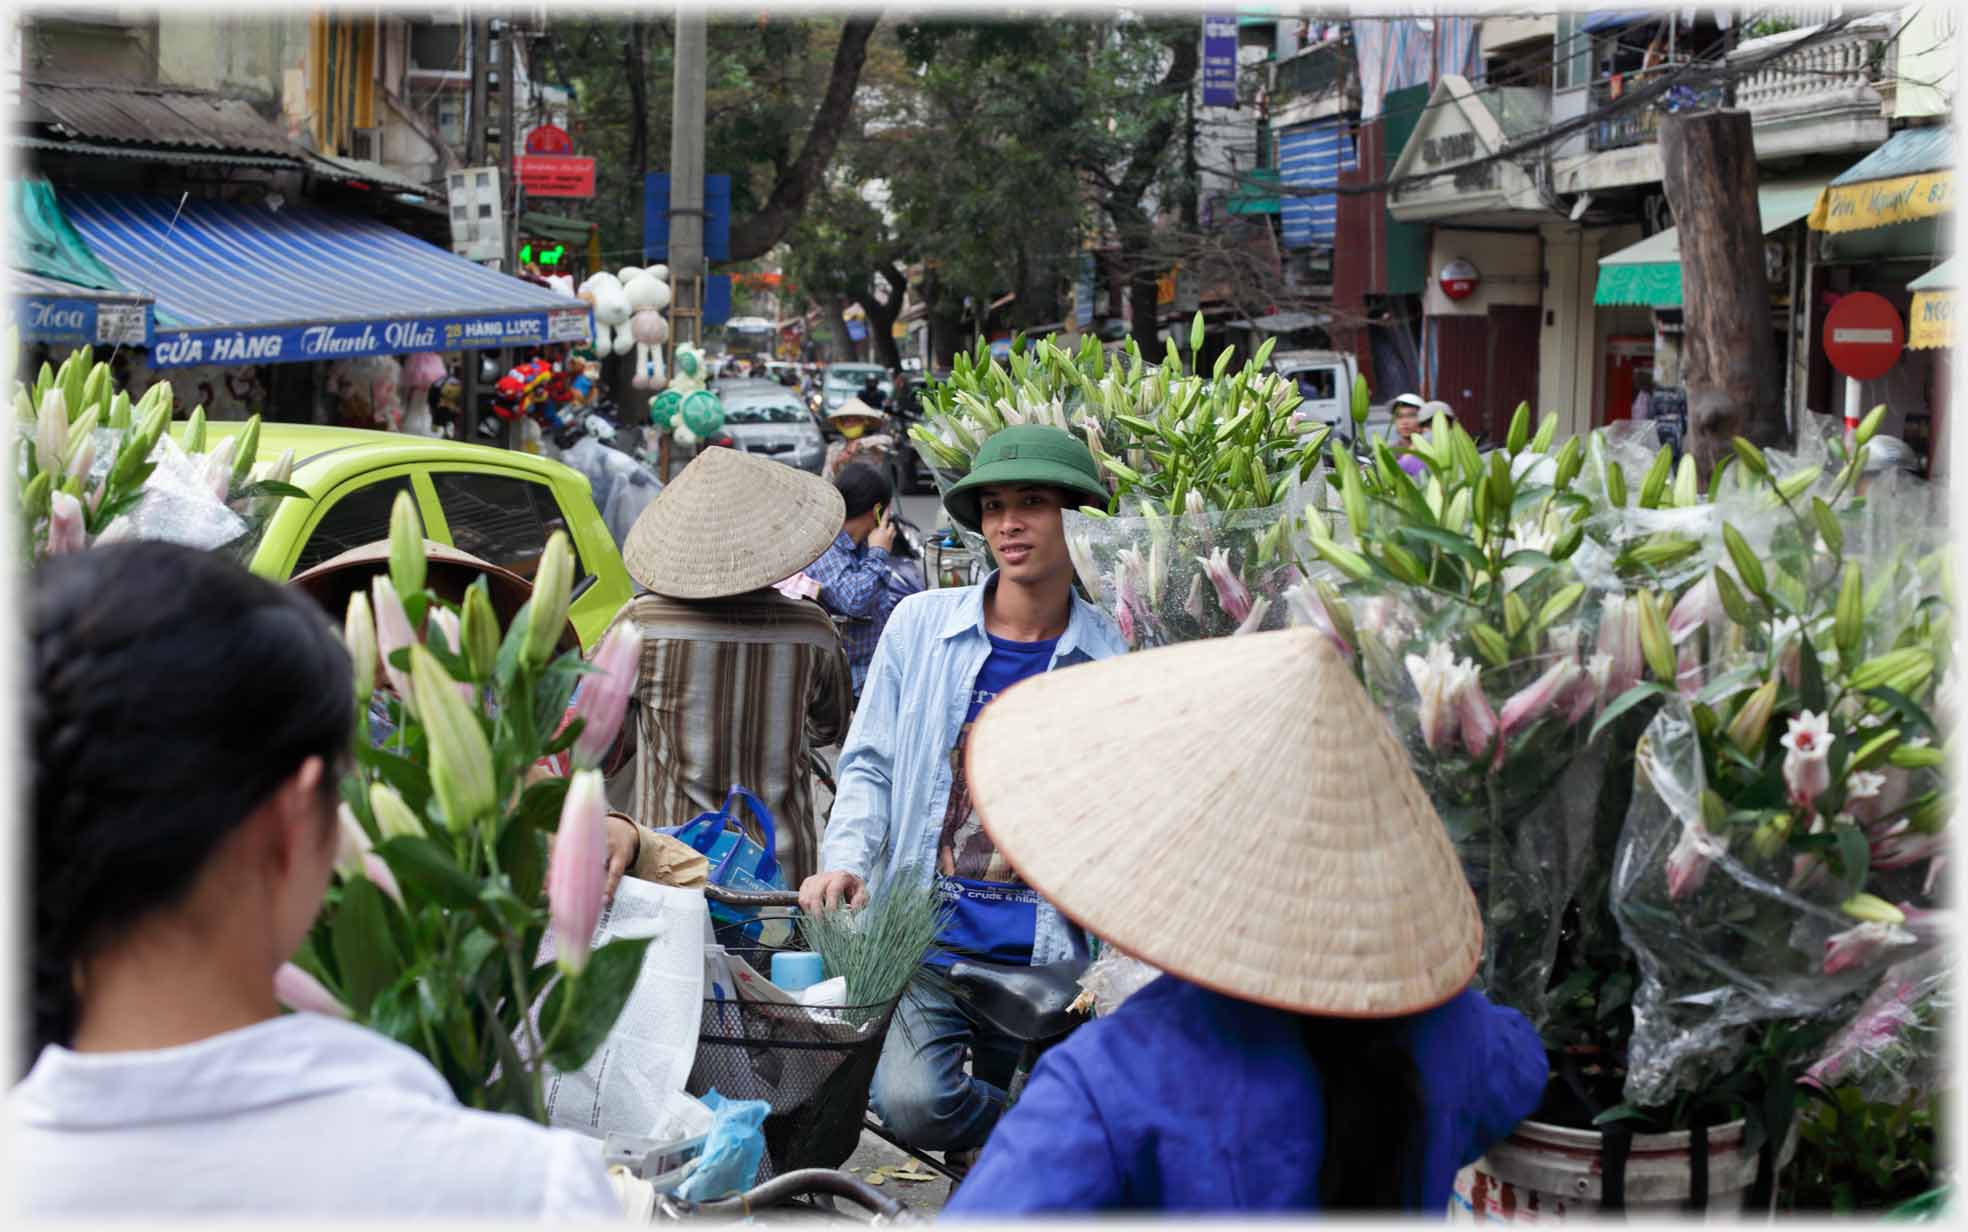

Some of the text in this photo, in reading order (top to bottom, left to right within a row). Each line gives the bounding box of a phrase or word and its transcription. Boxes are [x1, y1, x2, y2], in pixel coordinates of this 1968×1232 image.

[155, 321, 436, 365] CỬA HÀNG Thanh Nhã
[465, 320, 503, 336] HÀNG
